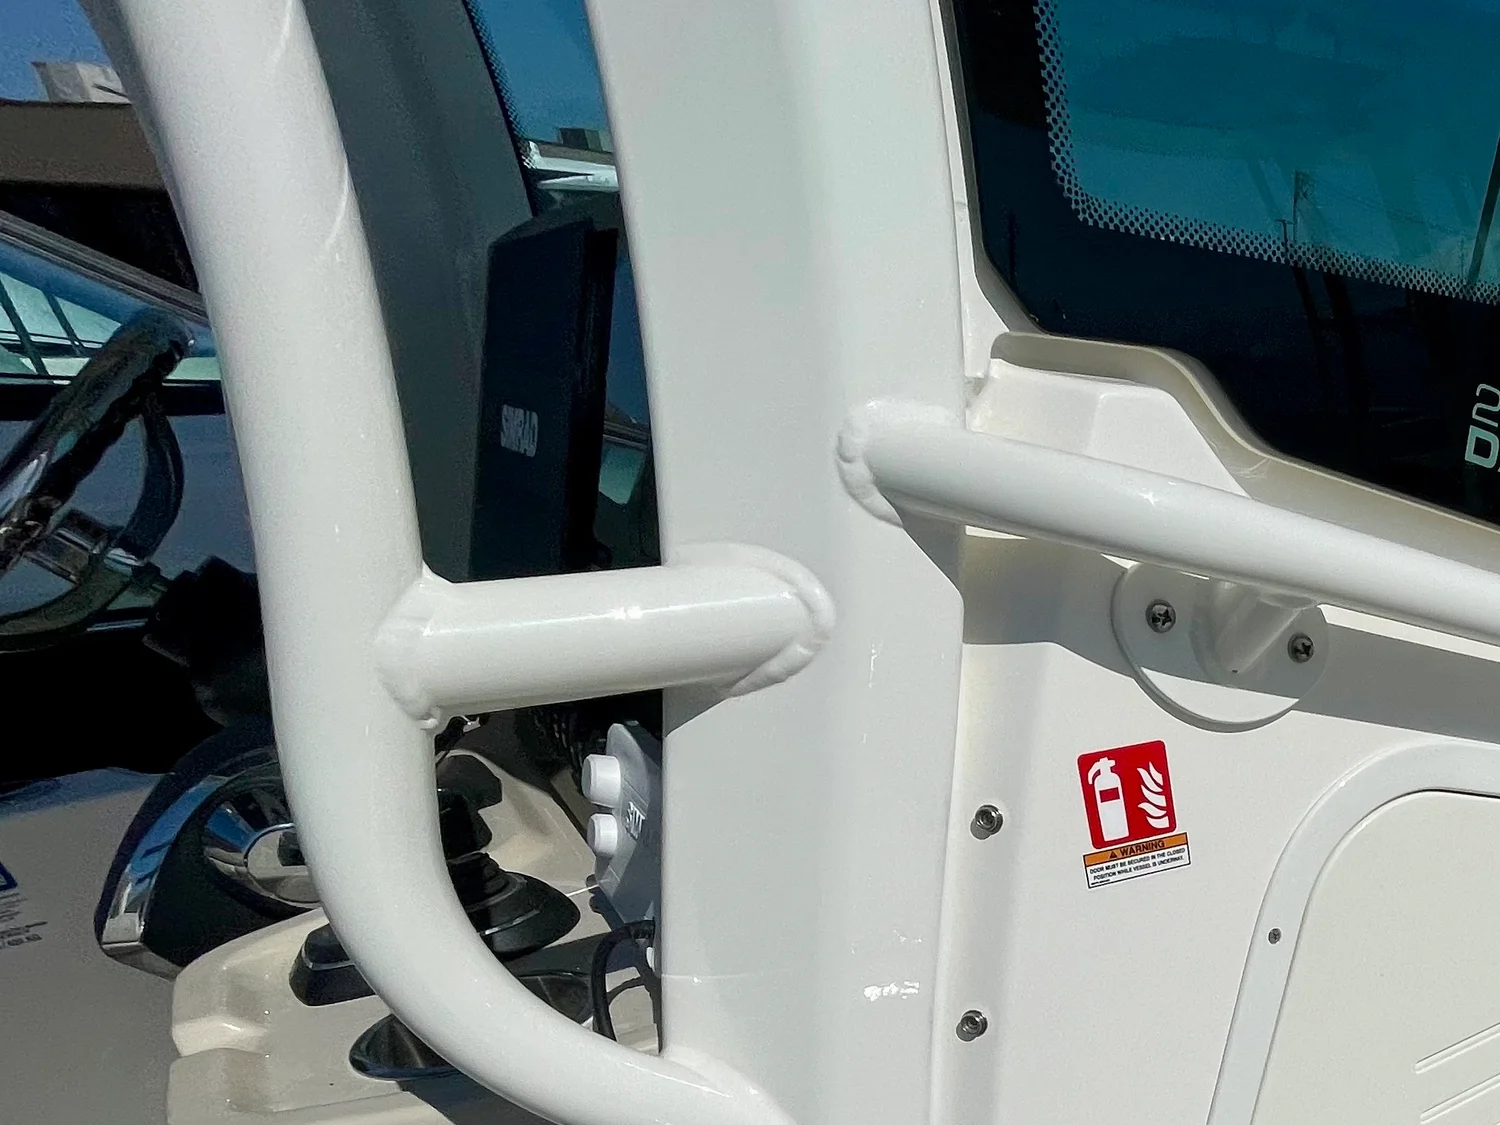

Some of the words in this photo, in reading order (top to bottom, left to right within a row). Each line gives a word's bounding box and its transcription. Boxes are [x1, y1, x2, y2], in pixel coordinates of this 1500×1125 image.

[1120, 840, 1165, 857] WARNING
[1090, 866, 1104, 874] DOOR
[1105, 863, 1119, 872] MUST
[1127, 856, 1150, 866] SECURED
[1167, 847, 1186, 856] CLOSED
[1093, 871, 1117, 881] POSITION
[1117, 867, 1132, 875] WHILE
[1133, 862, 1151, 872] VESSEL
